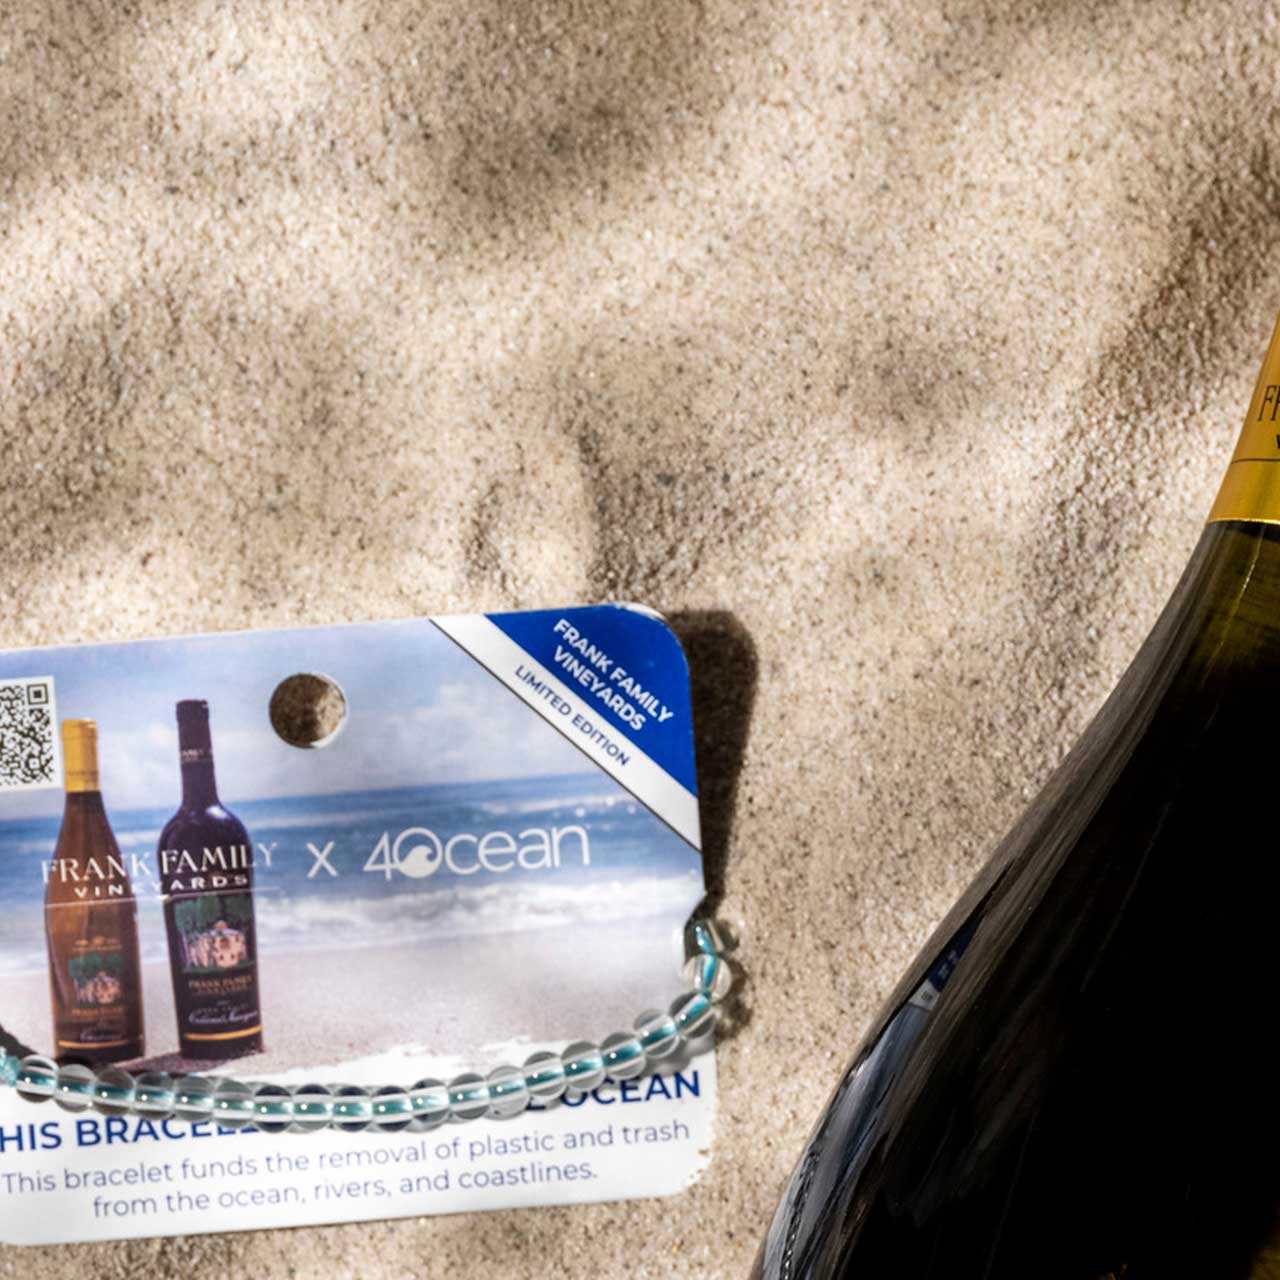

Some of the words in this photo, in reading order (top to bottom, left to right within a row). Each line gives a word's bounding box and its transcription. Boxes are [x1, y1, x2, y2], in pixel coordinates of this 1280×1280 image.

[553, 618, 614, 674] FRANK
[609, 667, 674, 723] FAMILY
[553, 645, 647, 731] VINEYARDS
[515, 665, 571, 717] LIMITED
[572, 714, 630, 766] EDITION
[41, 852, 151, 884] FRANK
[161, 842, 278, 875] FAMILY
[73, 873, 249, 898] VINEYARDS
[1, 1171, 56, 1195] This
[63, 1162, 173, 1190] bracelet
[180, 1155, 258, 1182] funds
[265, 1151, 310, 1173] the
[318, 1141, 427, 1168] removal
[434, 1137, 463, 1161] of
[469, 1130, 554, 1162] plastic
[562, 1124, 614, 1148] and
[622, 1119, 690, 1145] trash
[76, 1115, 259, 1147] BRACEL
[93, 1197, 158, 1218] from
[166, 1190, 210, 1213] the
[217, 1186, 306, 1209] ocean,
[314, 1178, 392, 1202] rivers,
[400, 1170, 450, 1195] and
[458, 1160, 598, 1190] coastlines.
